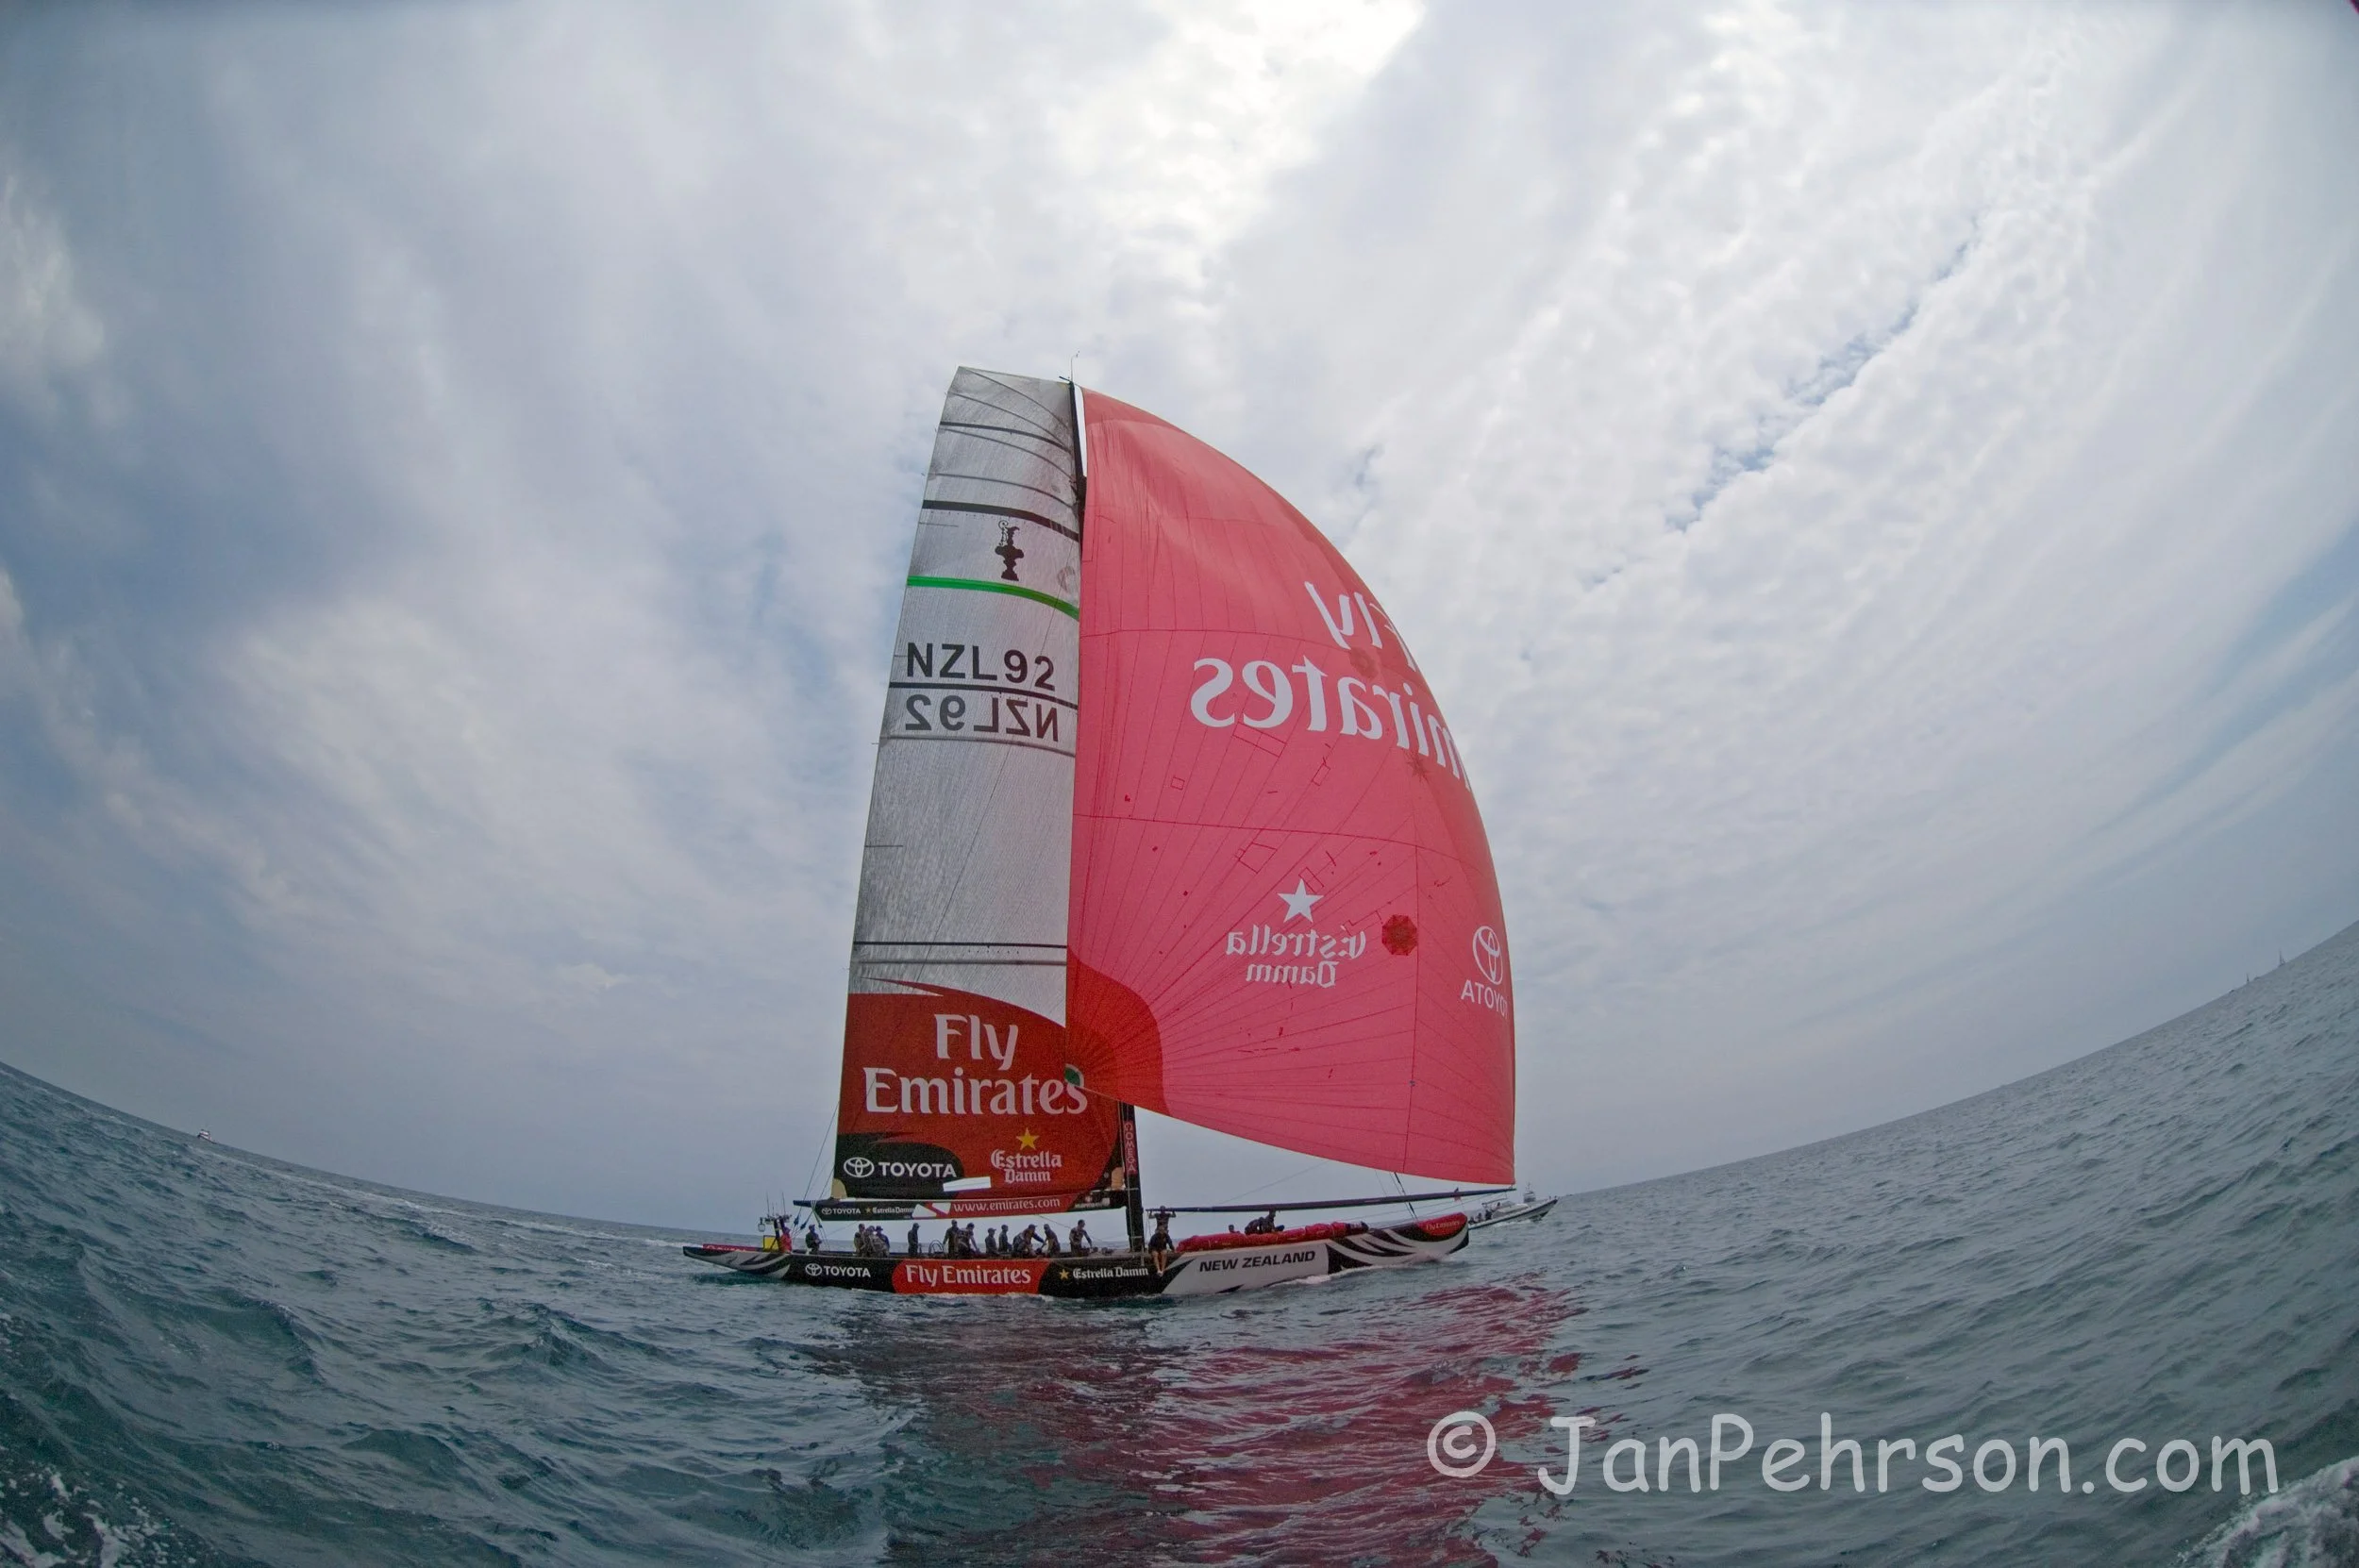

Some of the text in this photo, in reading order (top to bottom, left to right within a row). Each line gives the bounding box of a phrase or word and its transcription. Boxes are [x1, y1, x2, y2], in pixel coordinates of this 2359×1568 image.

[933, 1013, 1019, 1072] Fly
[862, 1066, 1089, 1116] Emirates
[990, 1147, 1062, 1170] Estrella
[878, 1161, 958, 1178] TOYOTA
[1004, 1168, 1051, 1184] Damm
[953, 1196, 1061, 1213] www.emirates.com
[824, 1265, 871, 1278] TOYOTA
[1198, 1250, 1316, 1273] NEW ZEALAND
[905, 1264, 1031, 1287] Fly Emirates
[1072, 1265, 1149, 1279] Estrella Damm
